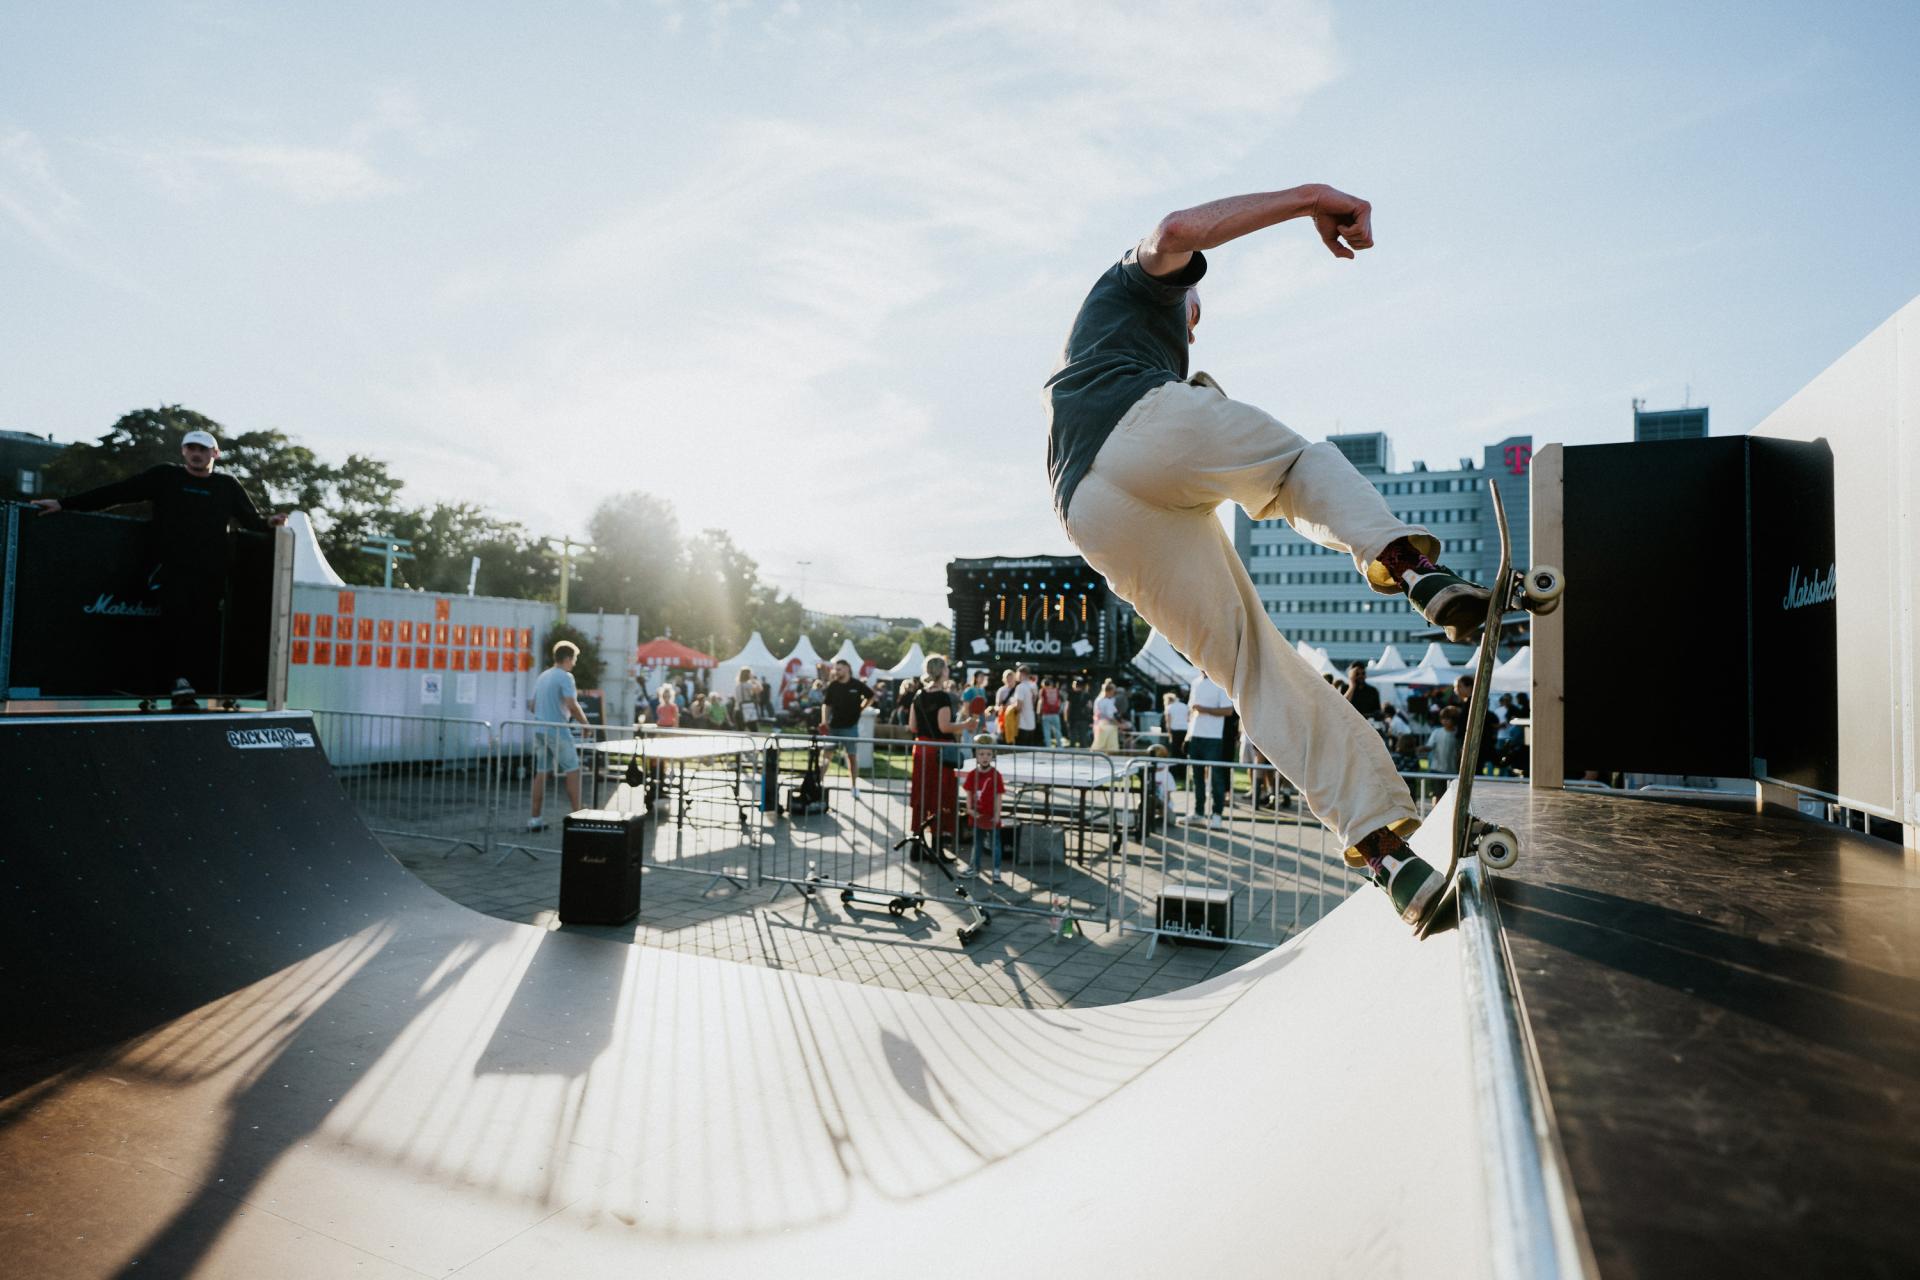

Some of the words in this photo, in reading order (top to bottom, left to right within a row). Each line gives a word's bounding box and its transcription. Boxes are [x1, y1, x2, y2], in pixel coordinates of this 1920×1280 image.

[1504, 445, 1532, 476] T
[83, 593, 162, 616] Marsha
[995, 630, 1061, 654] fritz-kola
[228, 728, 295, 746] BACKYARD
